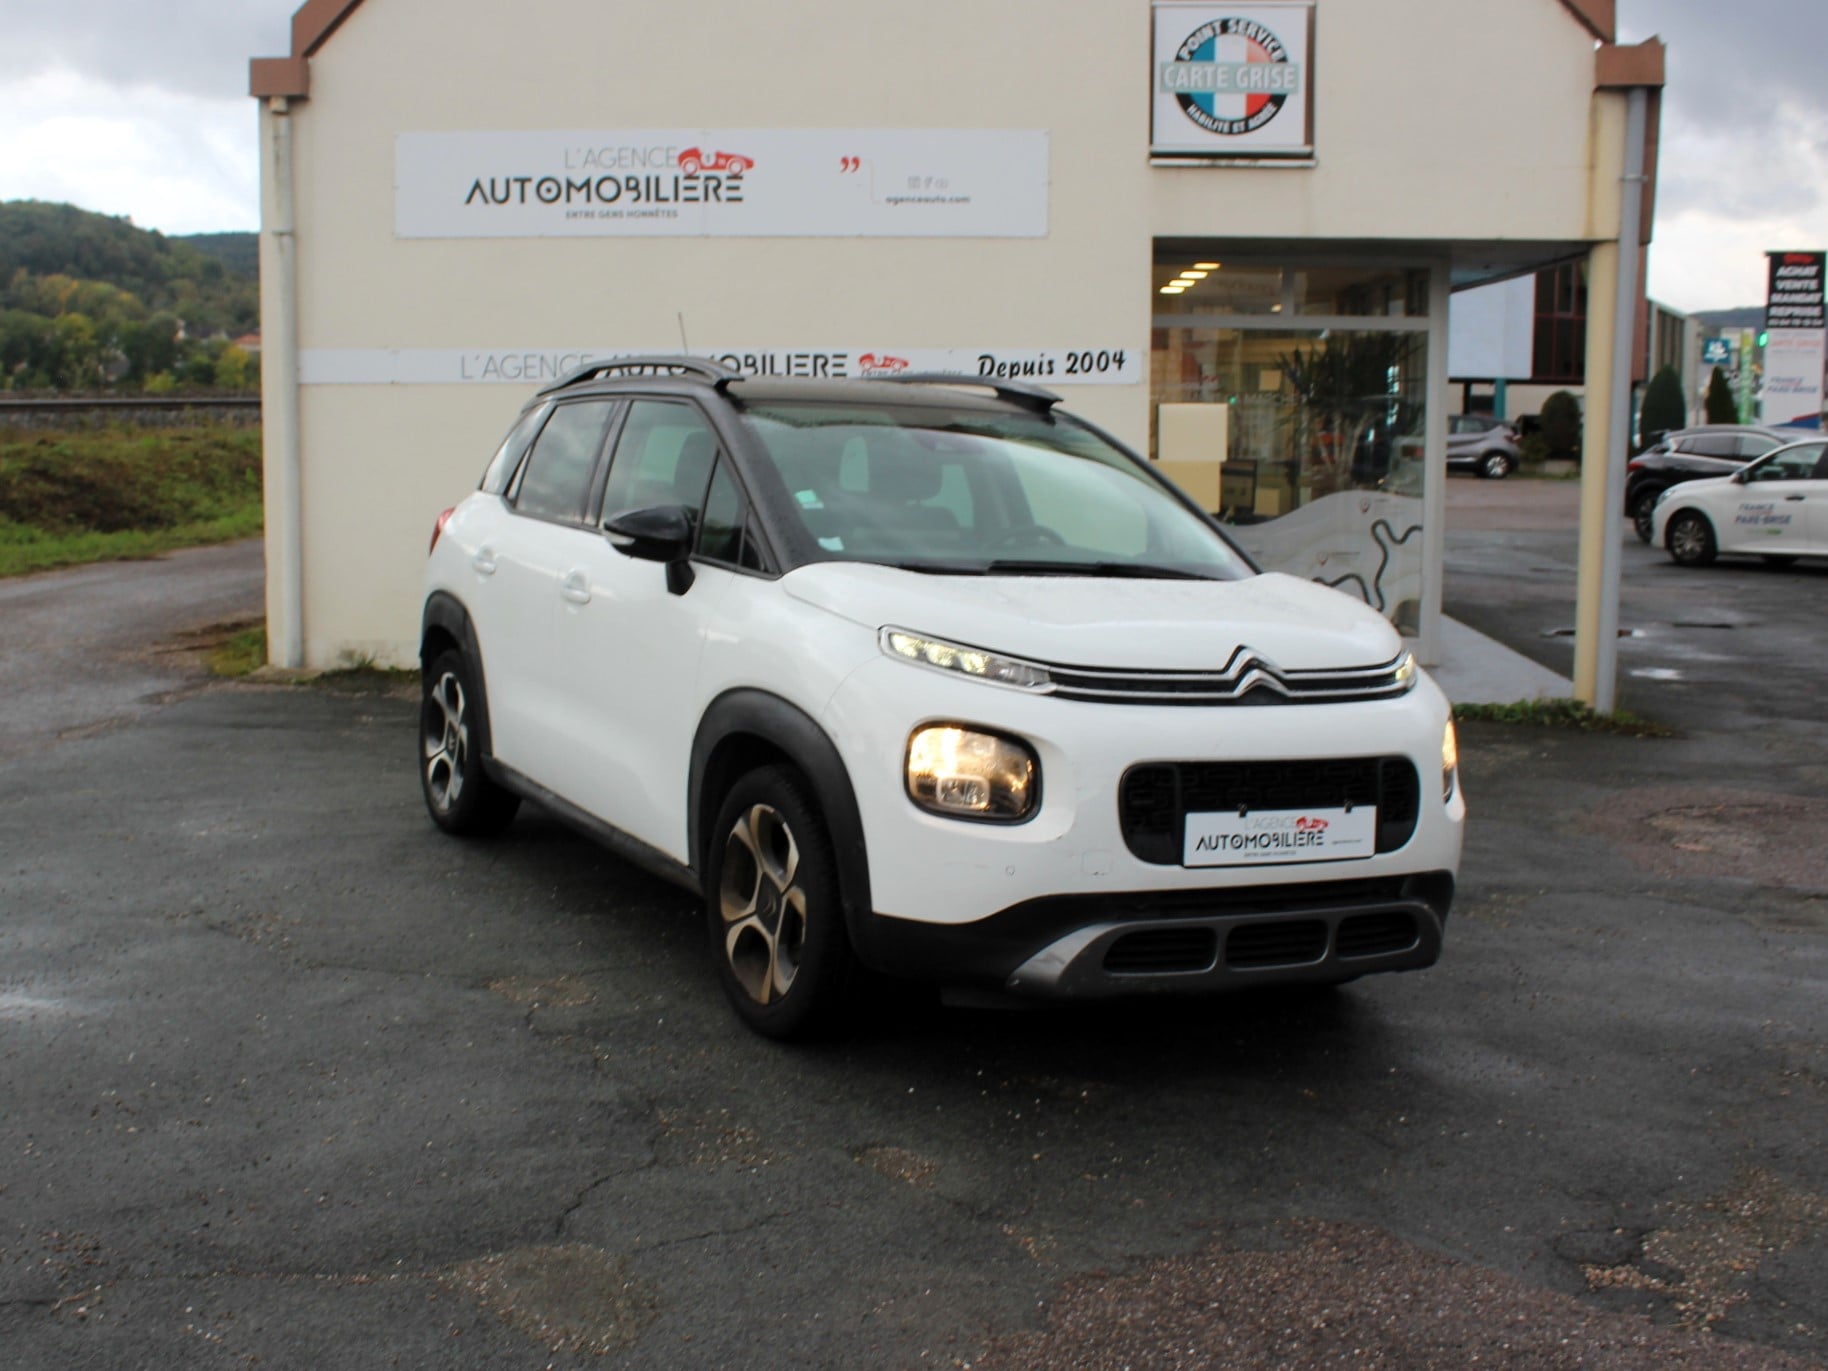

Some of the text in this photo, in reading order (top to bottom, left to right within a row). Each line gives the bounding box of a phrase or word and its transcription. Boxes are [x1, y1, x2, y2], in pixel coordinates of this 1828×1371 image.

[1178, 18, 1285, 62] POINT SERVICE
[1164, 65, 1296, 88] CARTE GRISE
[564, 146, 677, 169] L'AGENCE
[465, 174, 743, 204] AUTOMOBILIERE
[977, 352, 1055, 379] Depuis
[1065, 349, 1126, 375] 2004
[1196, 829, 1325, 851] AUTOMOBILIERE
